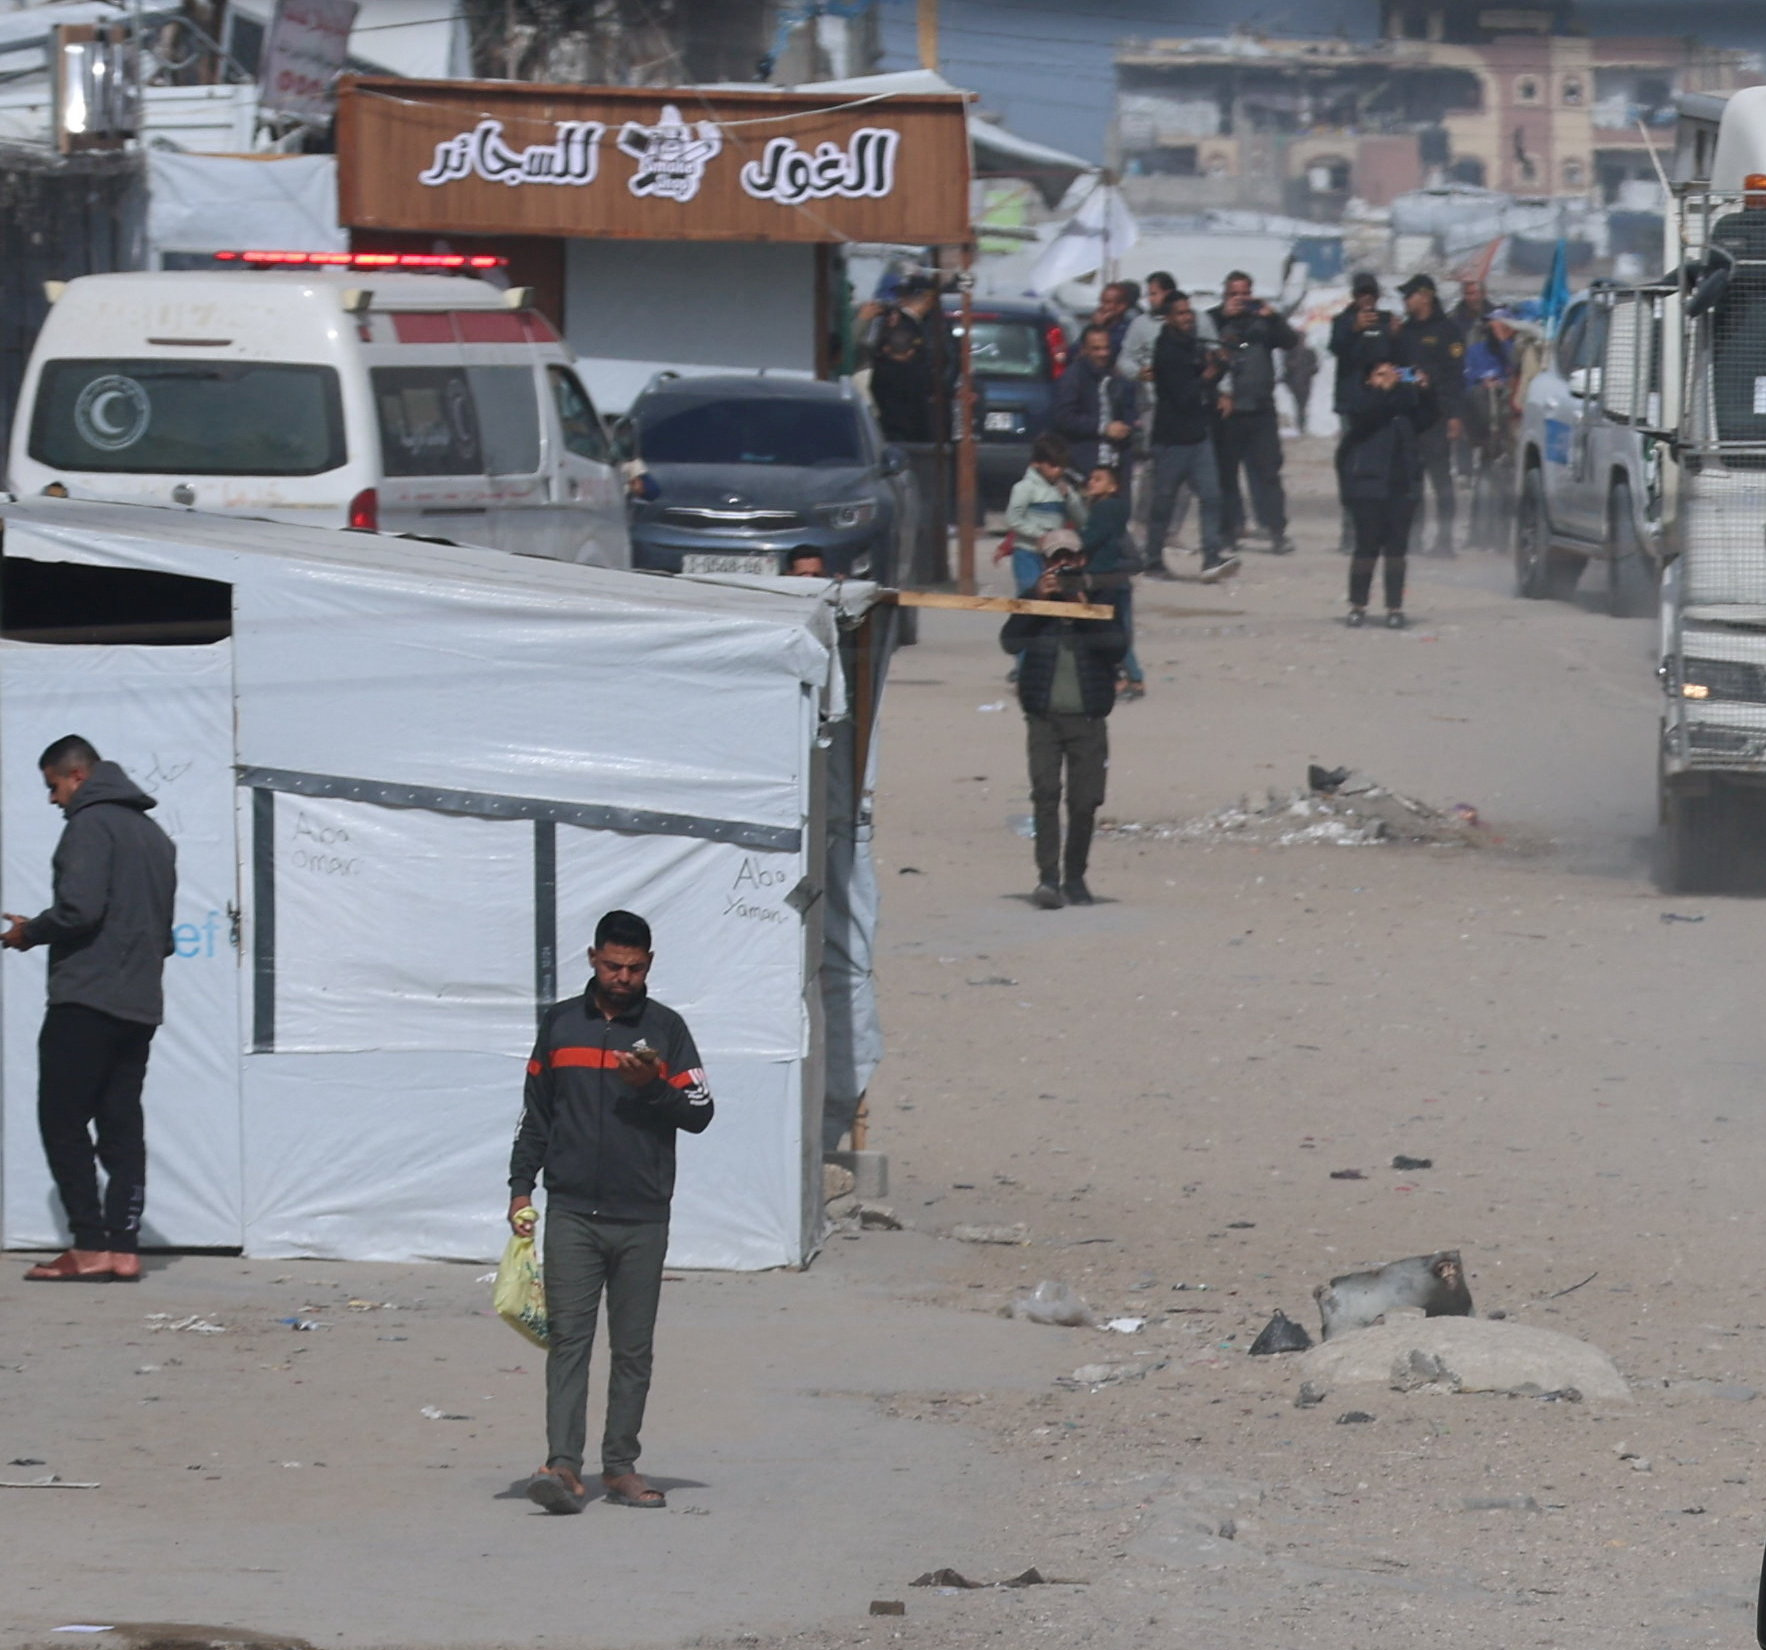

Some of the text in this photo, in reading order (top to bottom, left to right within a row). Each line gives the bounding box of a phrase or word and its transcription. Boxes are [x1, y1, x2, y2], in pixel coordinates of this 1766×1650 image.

[422, 122, 896, 202] الغول للسجائر
[732, 857, 787, 890] Abo
